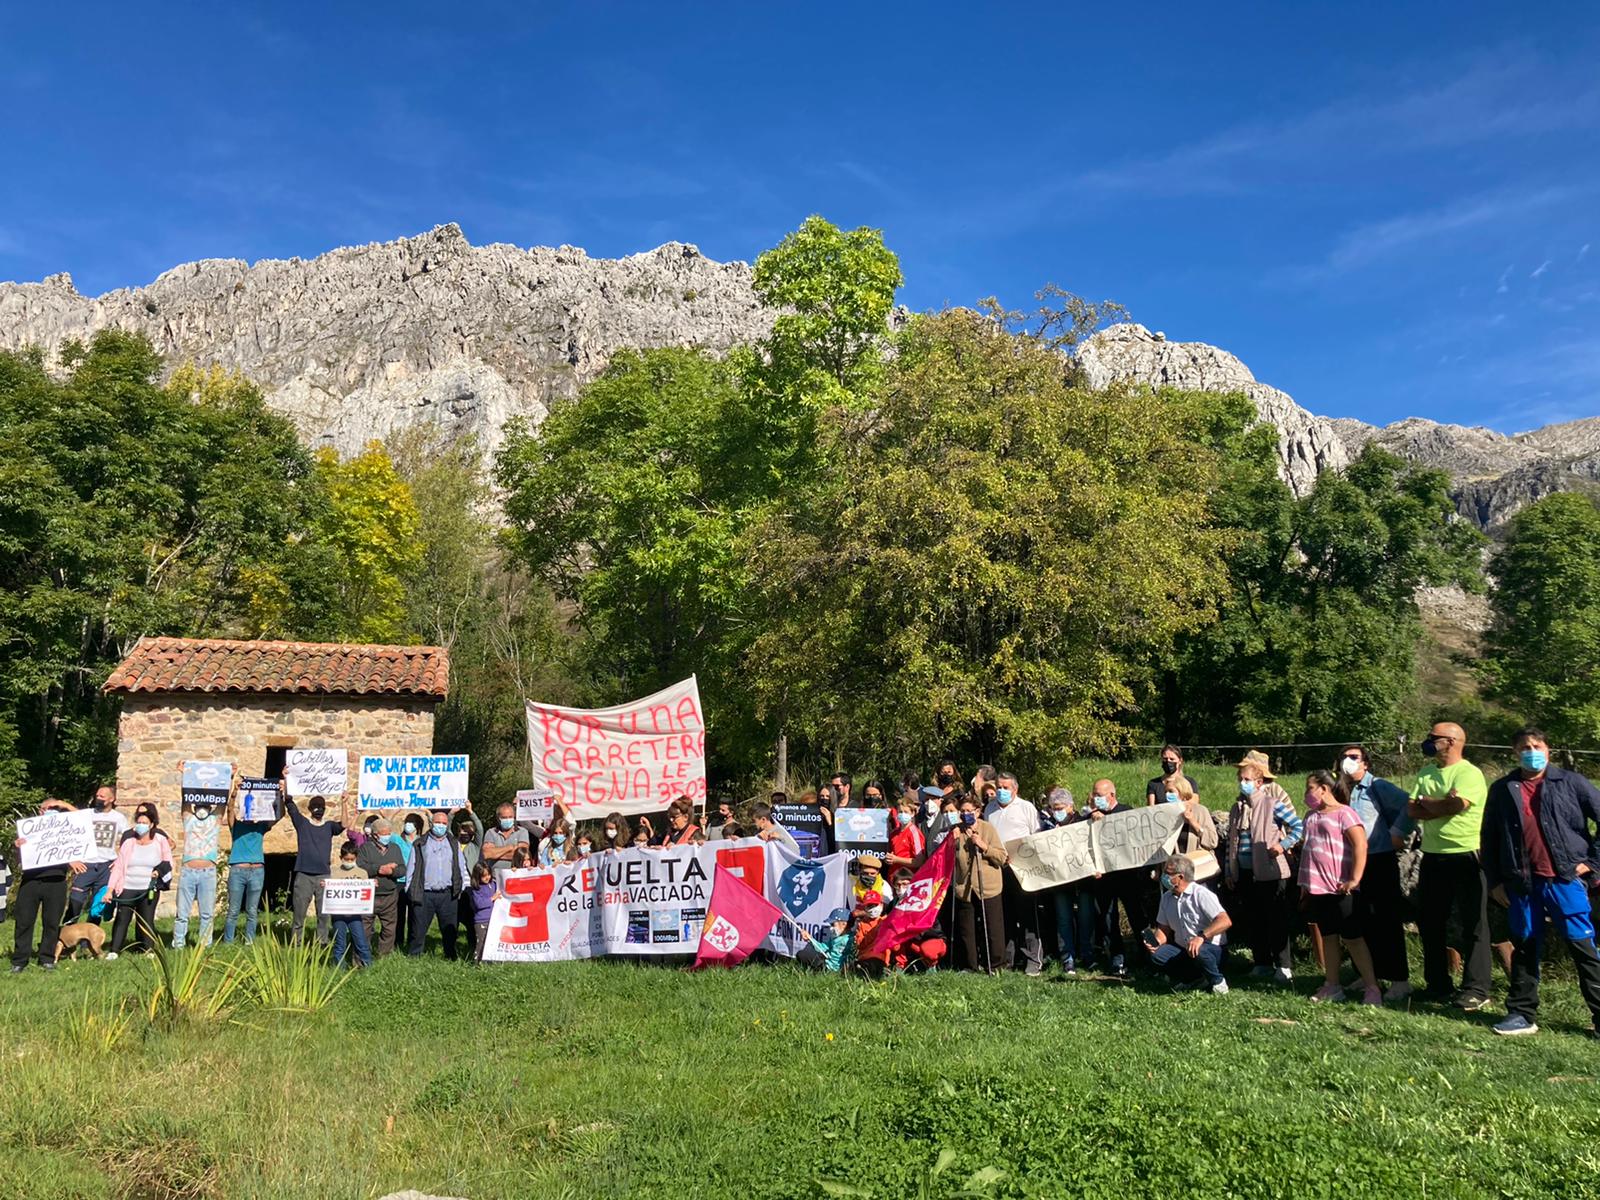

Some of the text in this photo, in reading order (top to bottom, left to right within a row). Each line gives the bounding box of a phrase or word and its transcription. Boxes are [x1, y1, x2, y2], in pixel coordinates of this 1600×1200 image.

[538, 697, 702, 746] POR UNA
[291, 751, 334, 765] Cubillas
[364, 757, 466, 773] POR UNA CARRETERA
[663, 763, 690, 779] LE
[547, 768, 650, 806] DIGNA
[184, 794, 226, 803] 100MBps
[22, 815, 69, 835] Cubillas
[786, 812, 822, 822] minutos
[558, 897, 578, 913] de
[582, 894, 594, 909] la
[497, 942, 550, 951] REVUELTA
